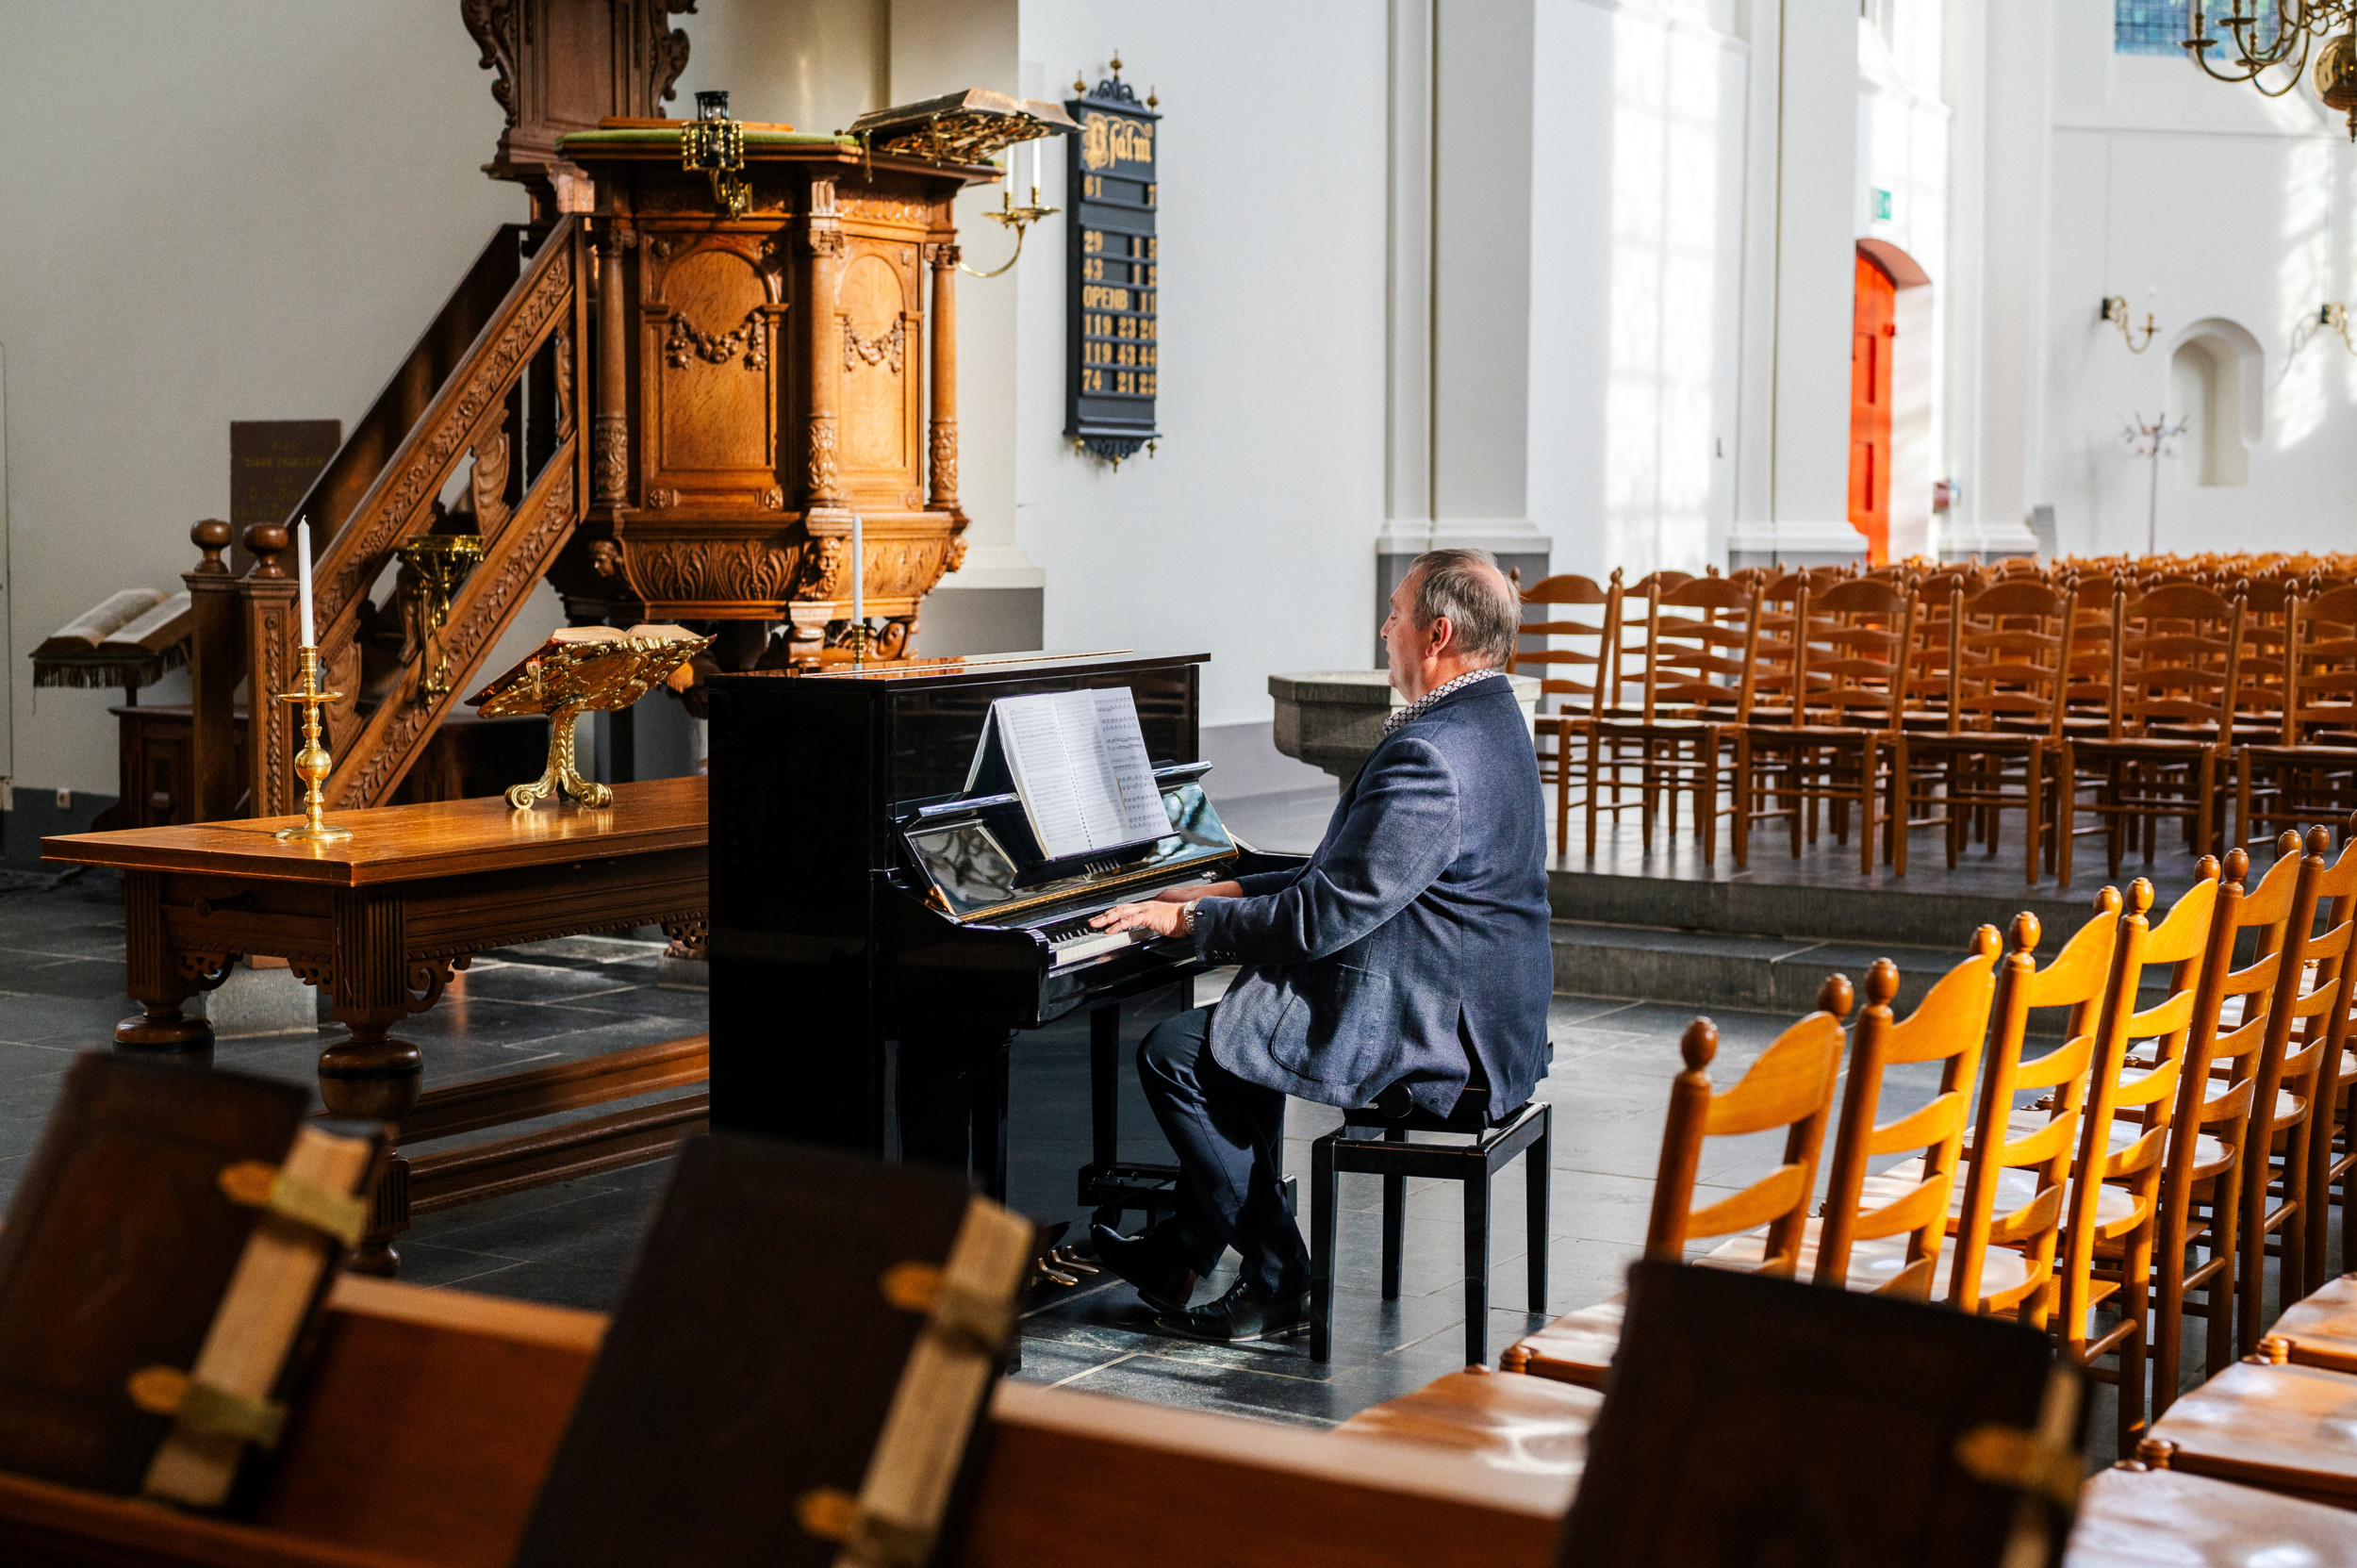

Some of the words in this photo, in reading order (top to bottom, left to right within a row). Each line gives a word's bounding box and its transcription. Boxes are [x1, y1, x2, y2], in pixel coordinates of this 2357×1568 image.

[1083, 112, 1153, 170] Psalm
[1134, 238, 1141, 258] 1
[1083, 257, 1103, 281] 43
[1134, 264, 1141, 286] 1
[1085, 313, 1112, 337] 119
[1118, 317, 1136, 338] 23
[1085, 340, 1112, 364] 119
[1117, 343, 1136, 366] 43
[1139, 346, 1156, 367] 44
[1083, 369, 1102, 391] 74
[1117, 371, 1135, 393] 21
[1139, 373, 1156, 394] 22
